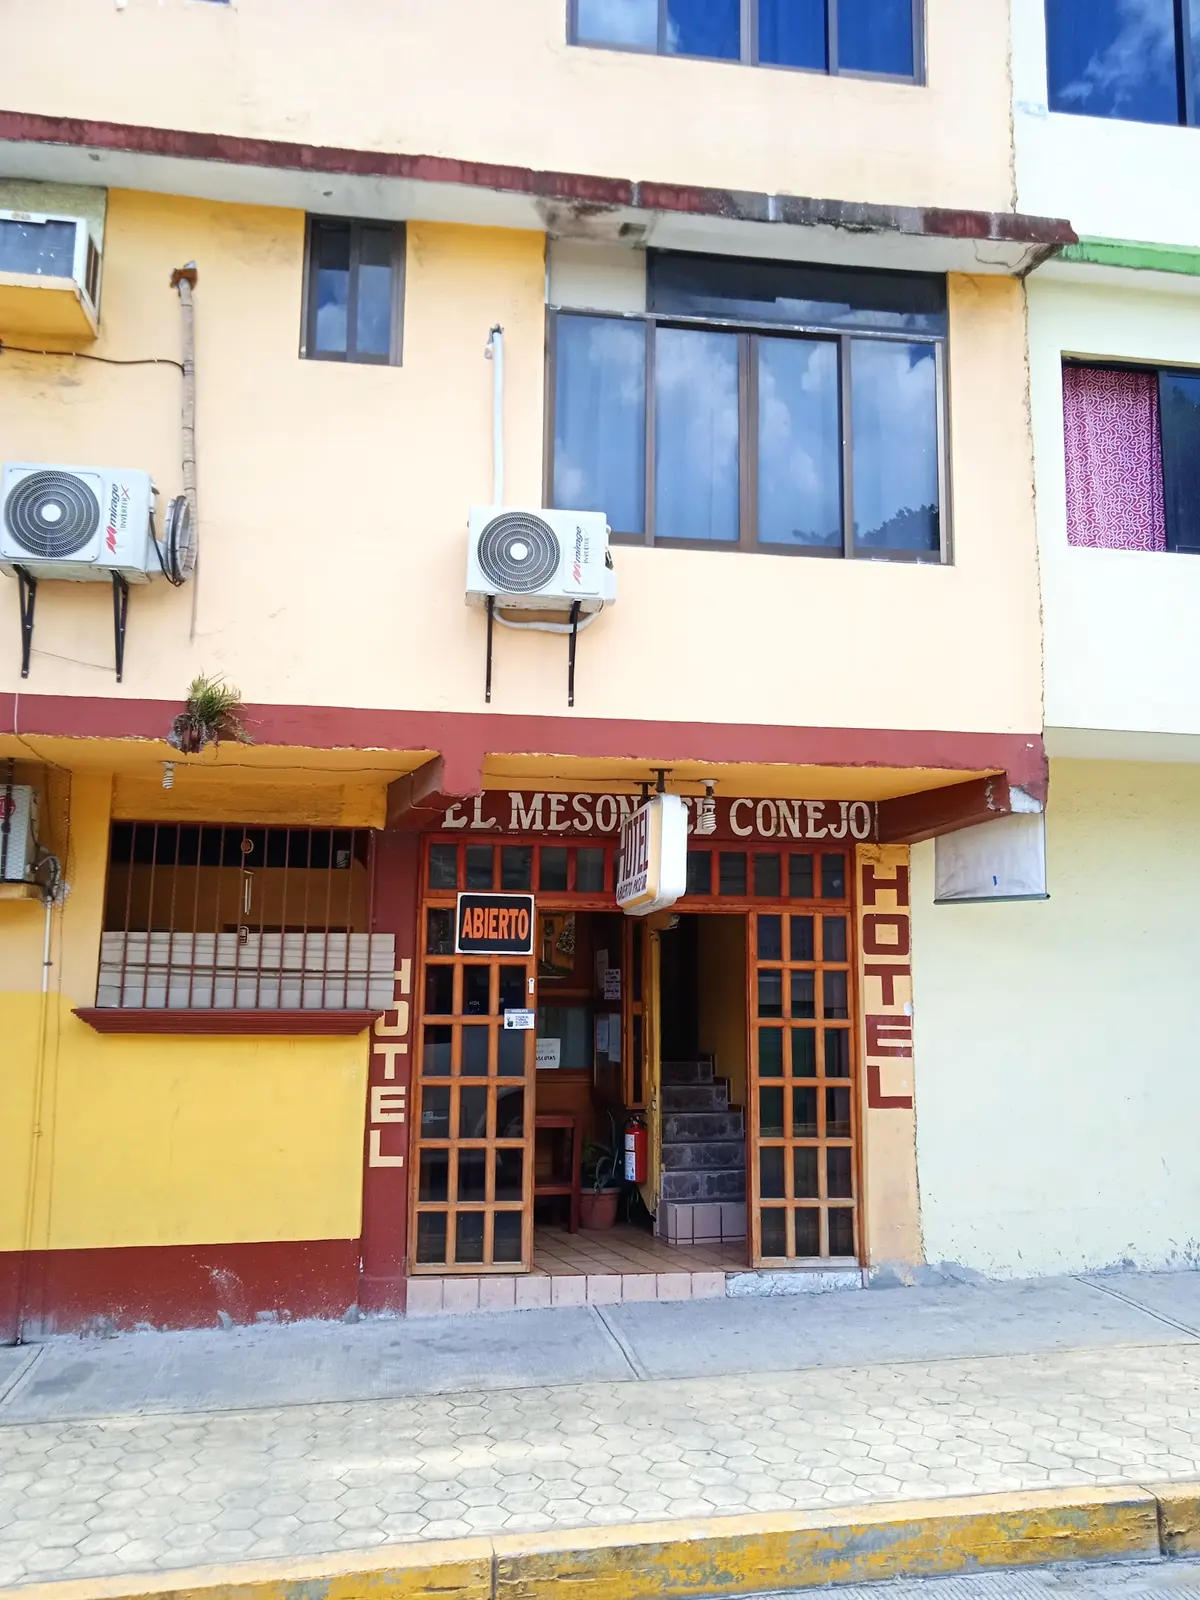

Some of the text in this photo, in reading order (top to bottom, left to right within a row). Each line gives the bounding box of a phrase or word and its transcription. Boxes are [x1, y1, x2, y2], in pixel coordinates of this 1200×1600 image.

[441, 791, 497, 829] EL
[508, 792, 641, 832] MESON
[729, 798, 871, 840] CONEJO
[619, 808, 649, 882] HOTEL
[461, 907, 529, 940] ABIERTO
[862, 864, 913, 1110] HOTEL
